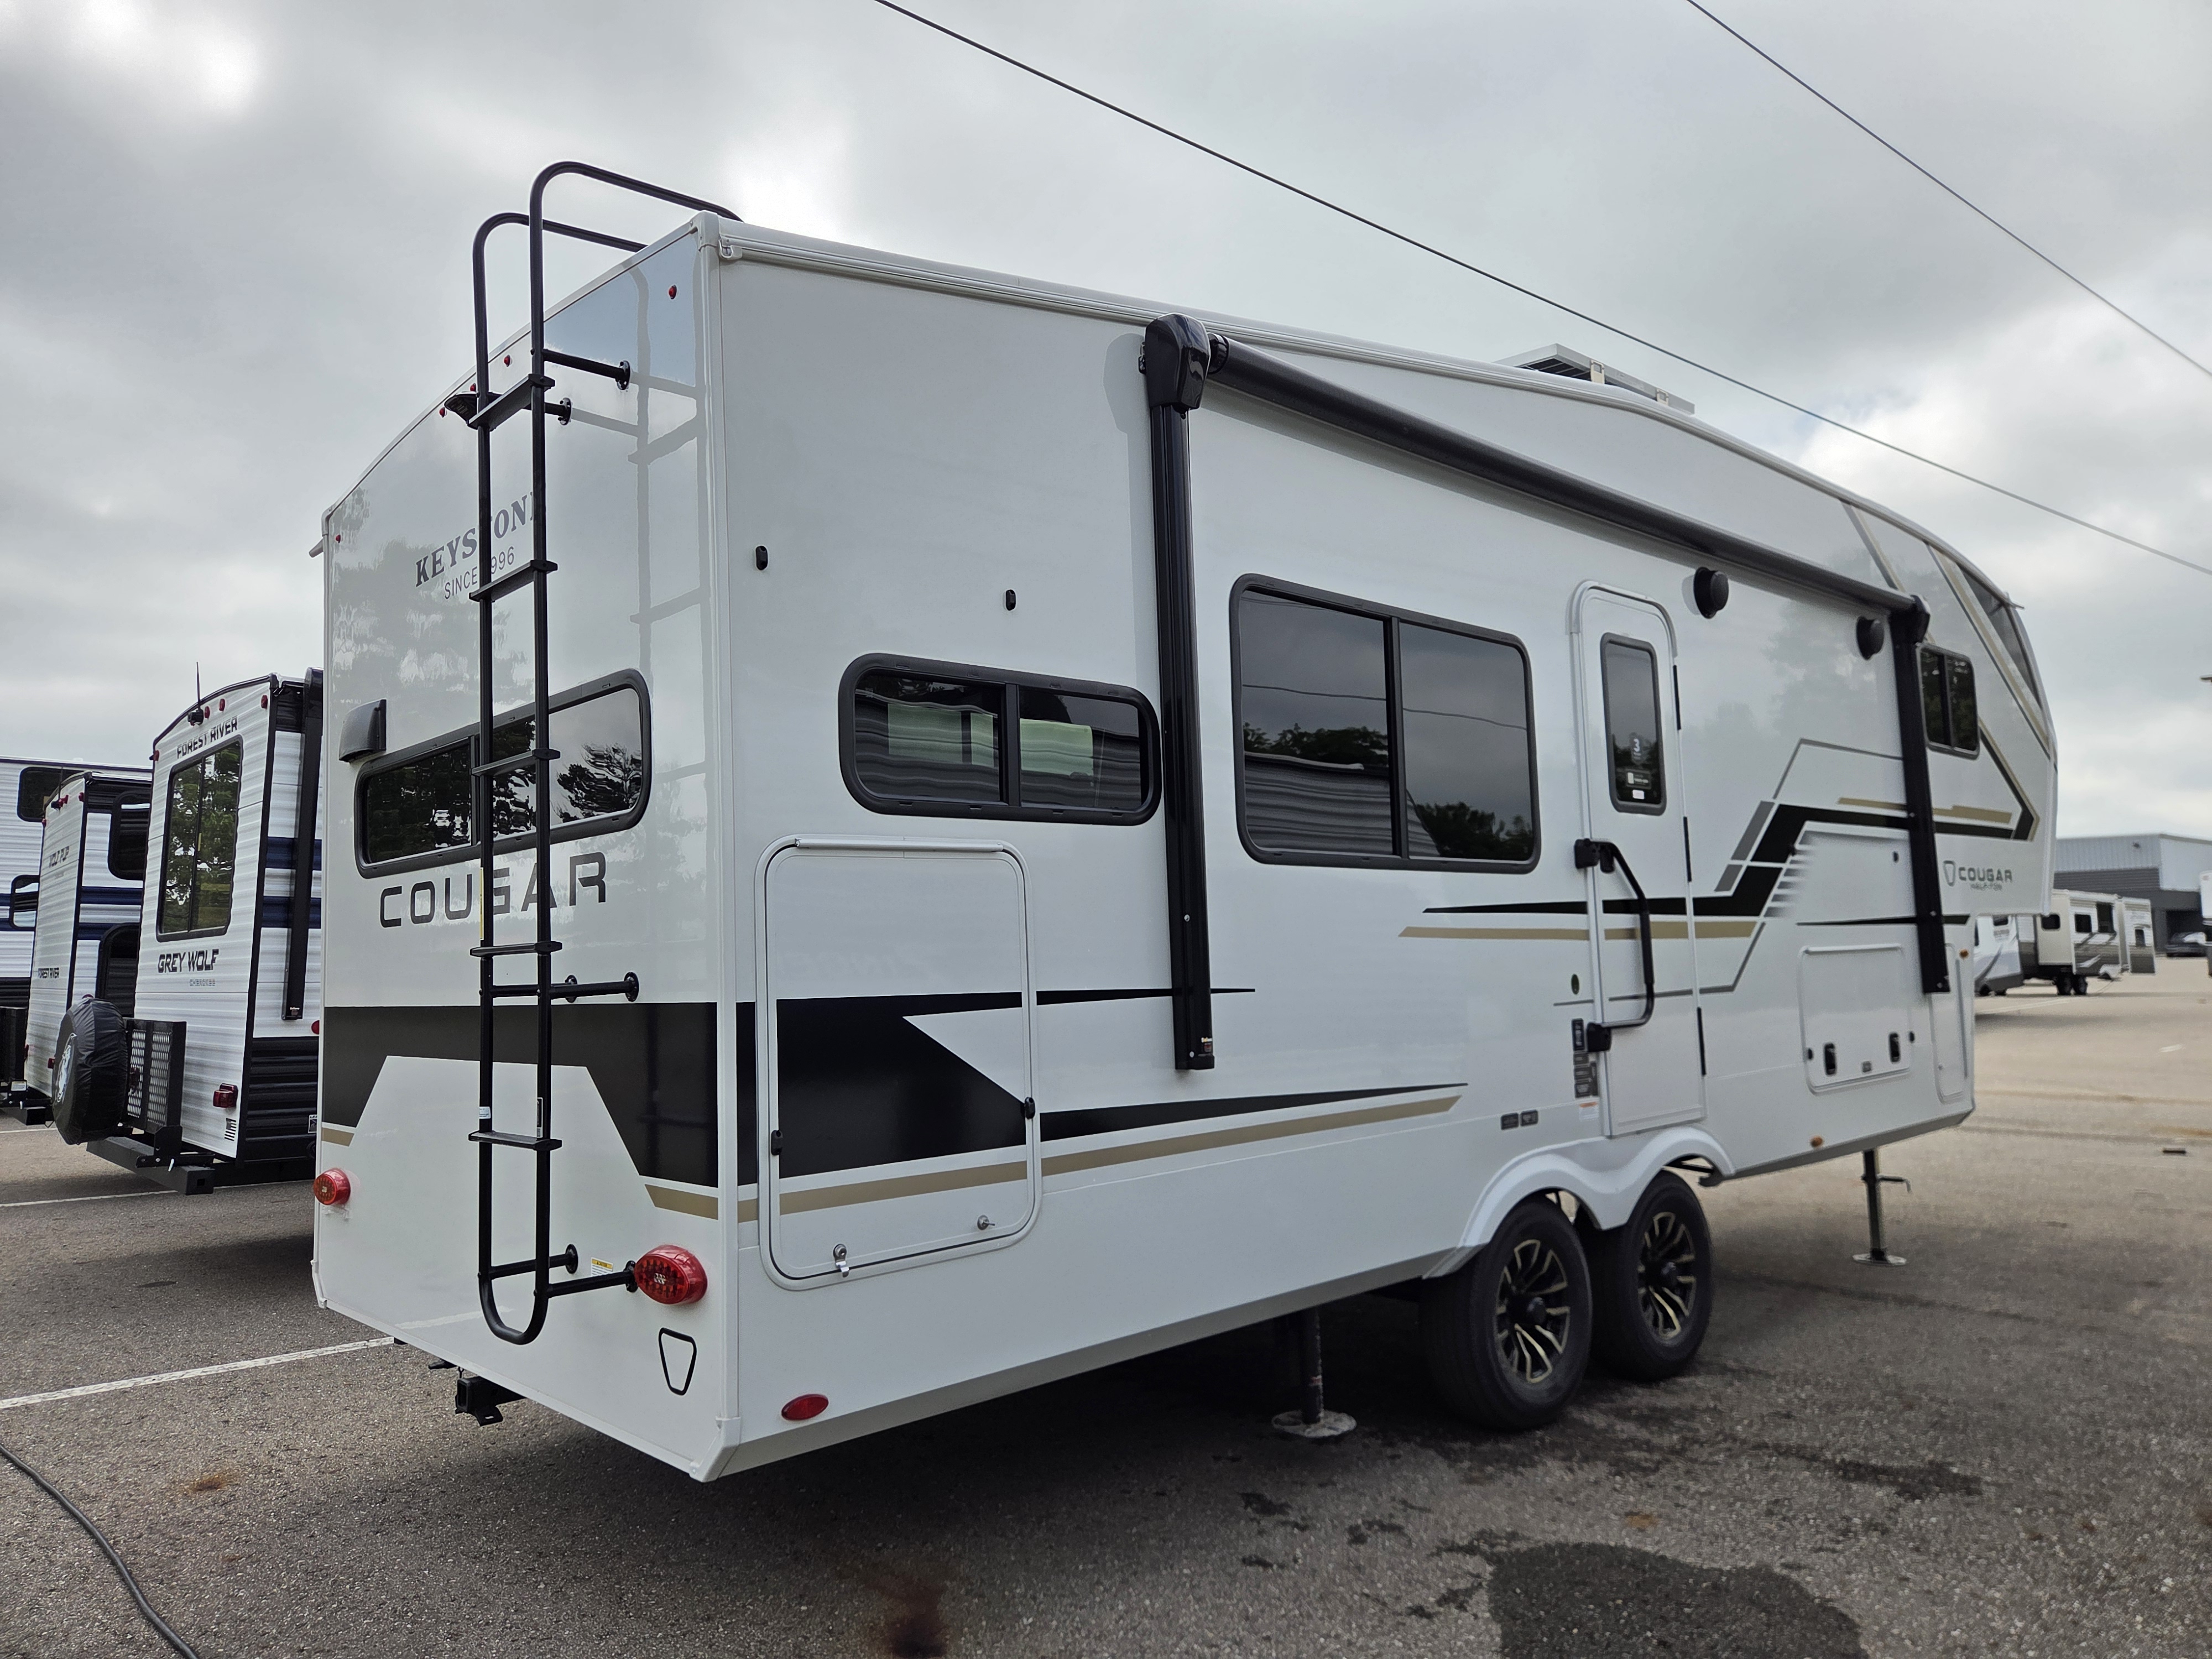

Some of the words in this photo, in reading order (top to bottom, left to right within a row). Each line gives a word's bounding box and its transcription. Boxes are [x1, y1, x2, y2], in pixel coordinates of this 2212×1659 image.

[416, 492, 533, 587] KEYSON
[445, 566, 478, 599] SINCE
[491, 546, 514, 575] 996
[177, 732, 208, 759] FOREST
[211, 715, 238, 743] RIVER
[380, 852, 606, 928] COUGAR
[1958, 867, 2012, 883] COUGAR
[158, 951, 186, 973] GREY
[188, 948, 219, 972] WOLF
